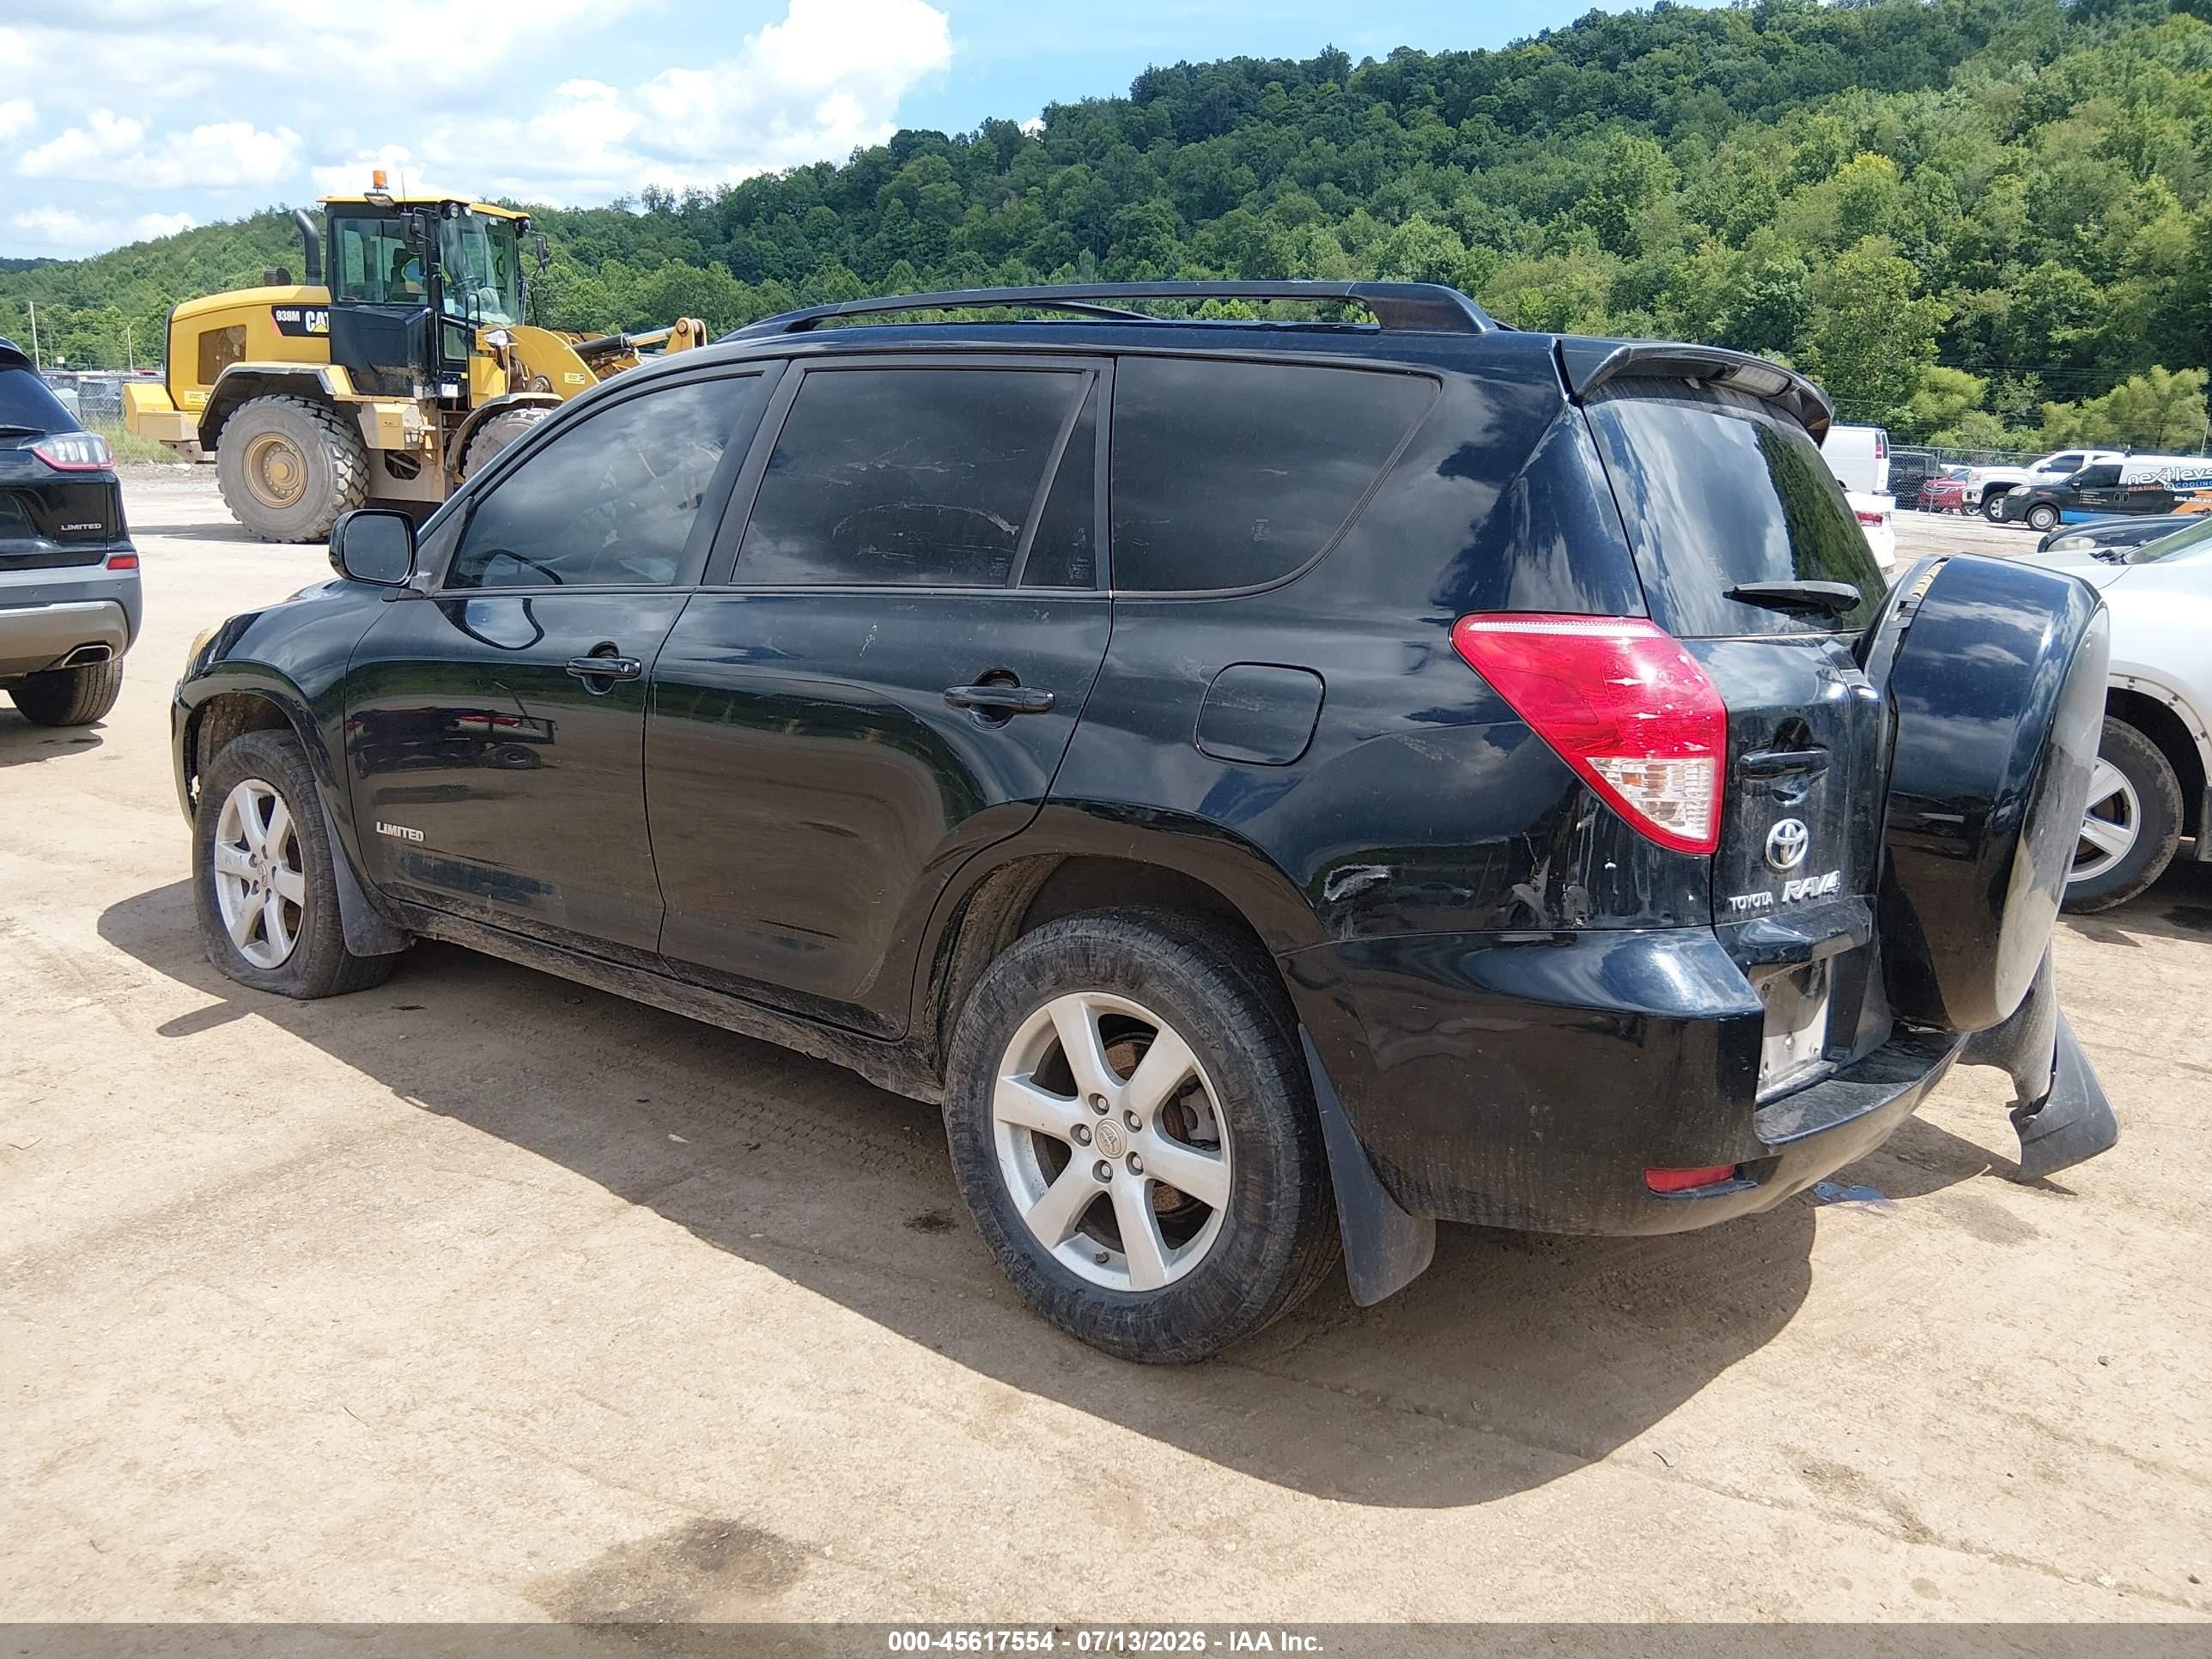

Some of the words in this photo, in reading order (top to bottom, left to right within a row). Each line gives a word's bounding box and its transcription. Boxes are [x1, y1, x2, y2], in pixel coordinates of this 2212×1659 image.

[276, 310, 301, 322] 938M
[376, 821, 424, 842] LIMITED
[1728, 891, 1773, 911] TOYOTA
[1781, 870, 1840, 902] RAV4
